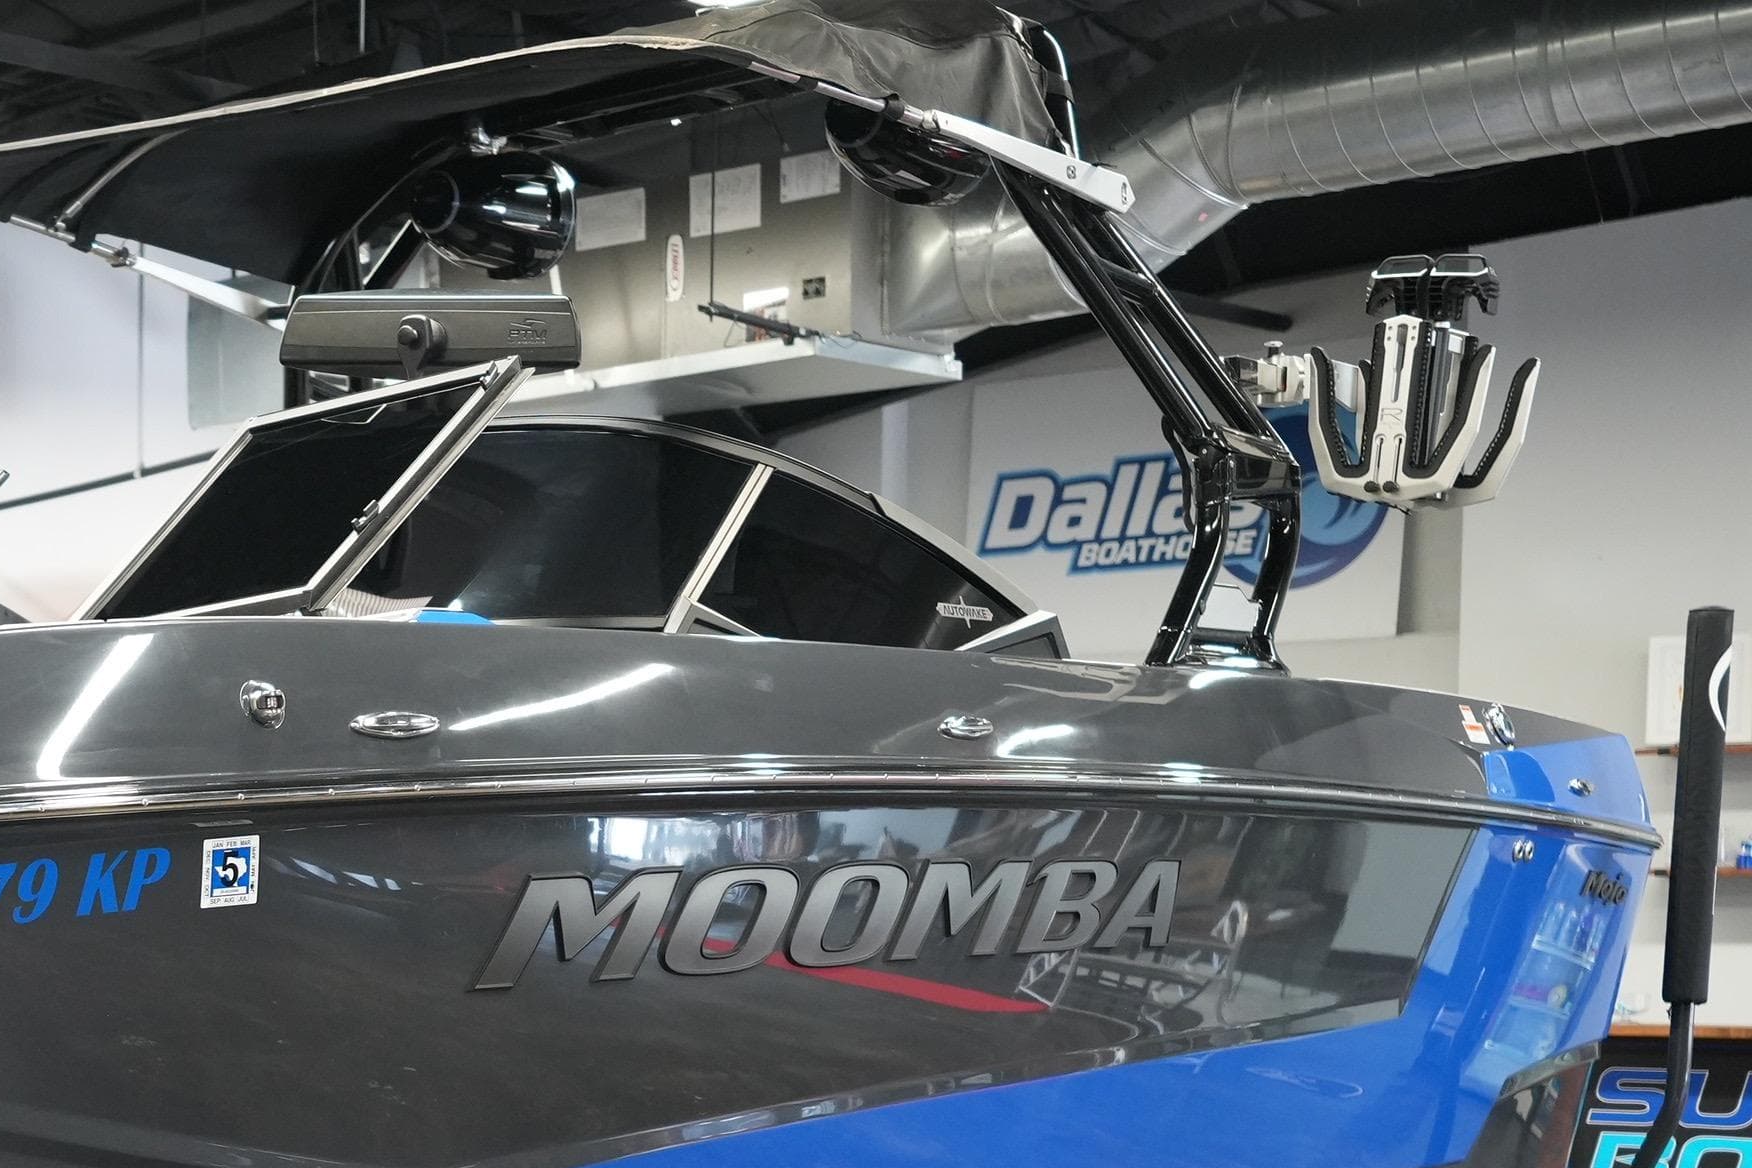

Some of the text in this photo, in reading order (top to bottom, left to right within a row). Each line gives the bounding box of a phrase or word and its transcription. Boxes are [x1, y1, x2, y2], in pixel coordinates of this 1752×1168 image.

[943, 605, 988, 619] AUTOWAKE
[76, 847, 171, 918] KP
[221, 849, 239, 887] 5
[1581, 869, 1628, 905] Mojo
[466, 858, 1182, 992] MOOMBA
